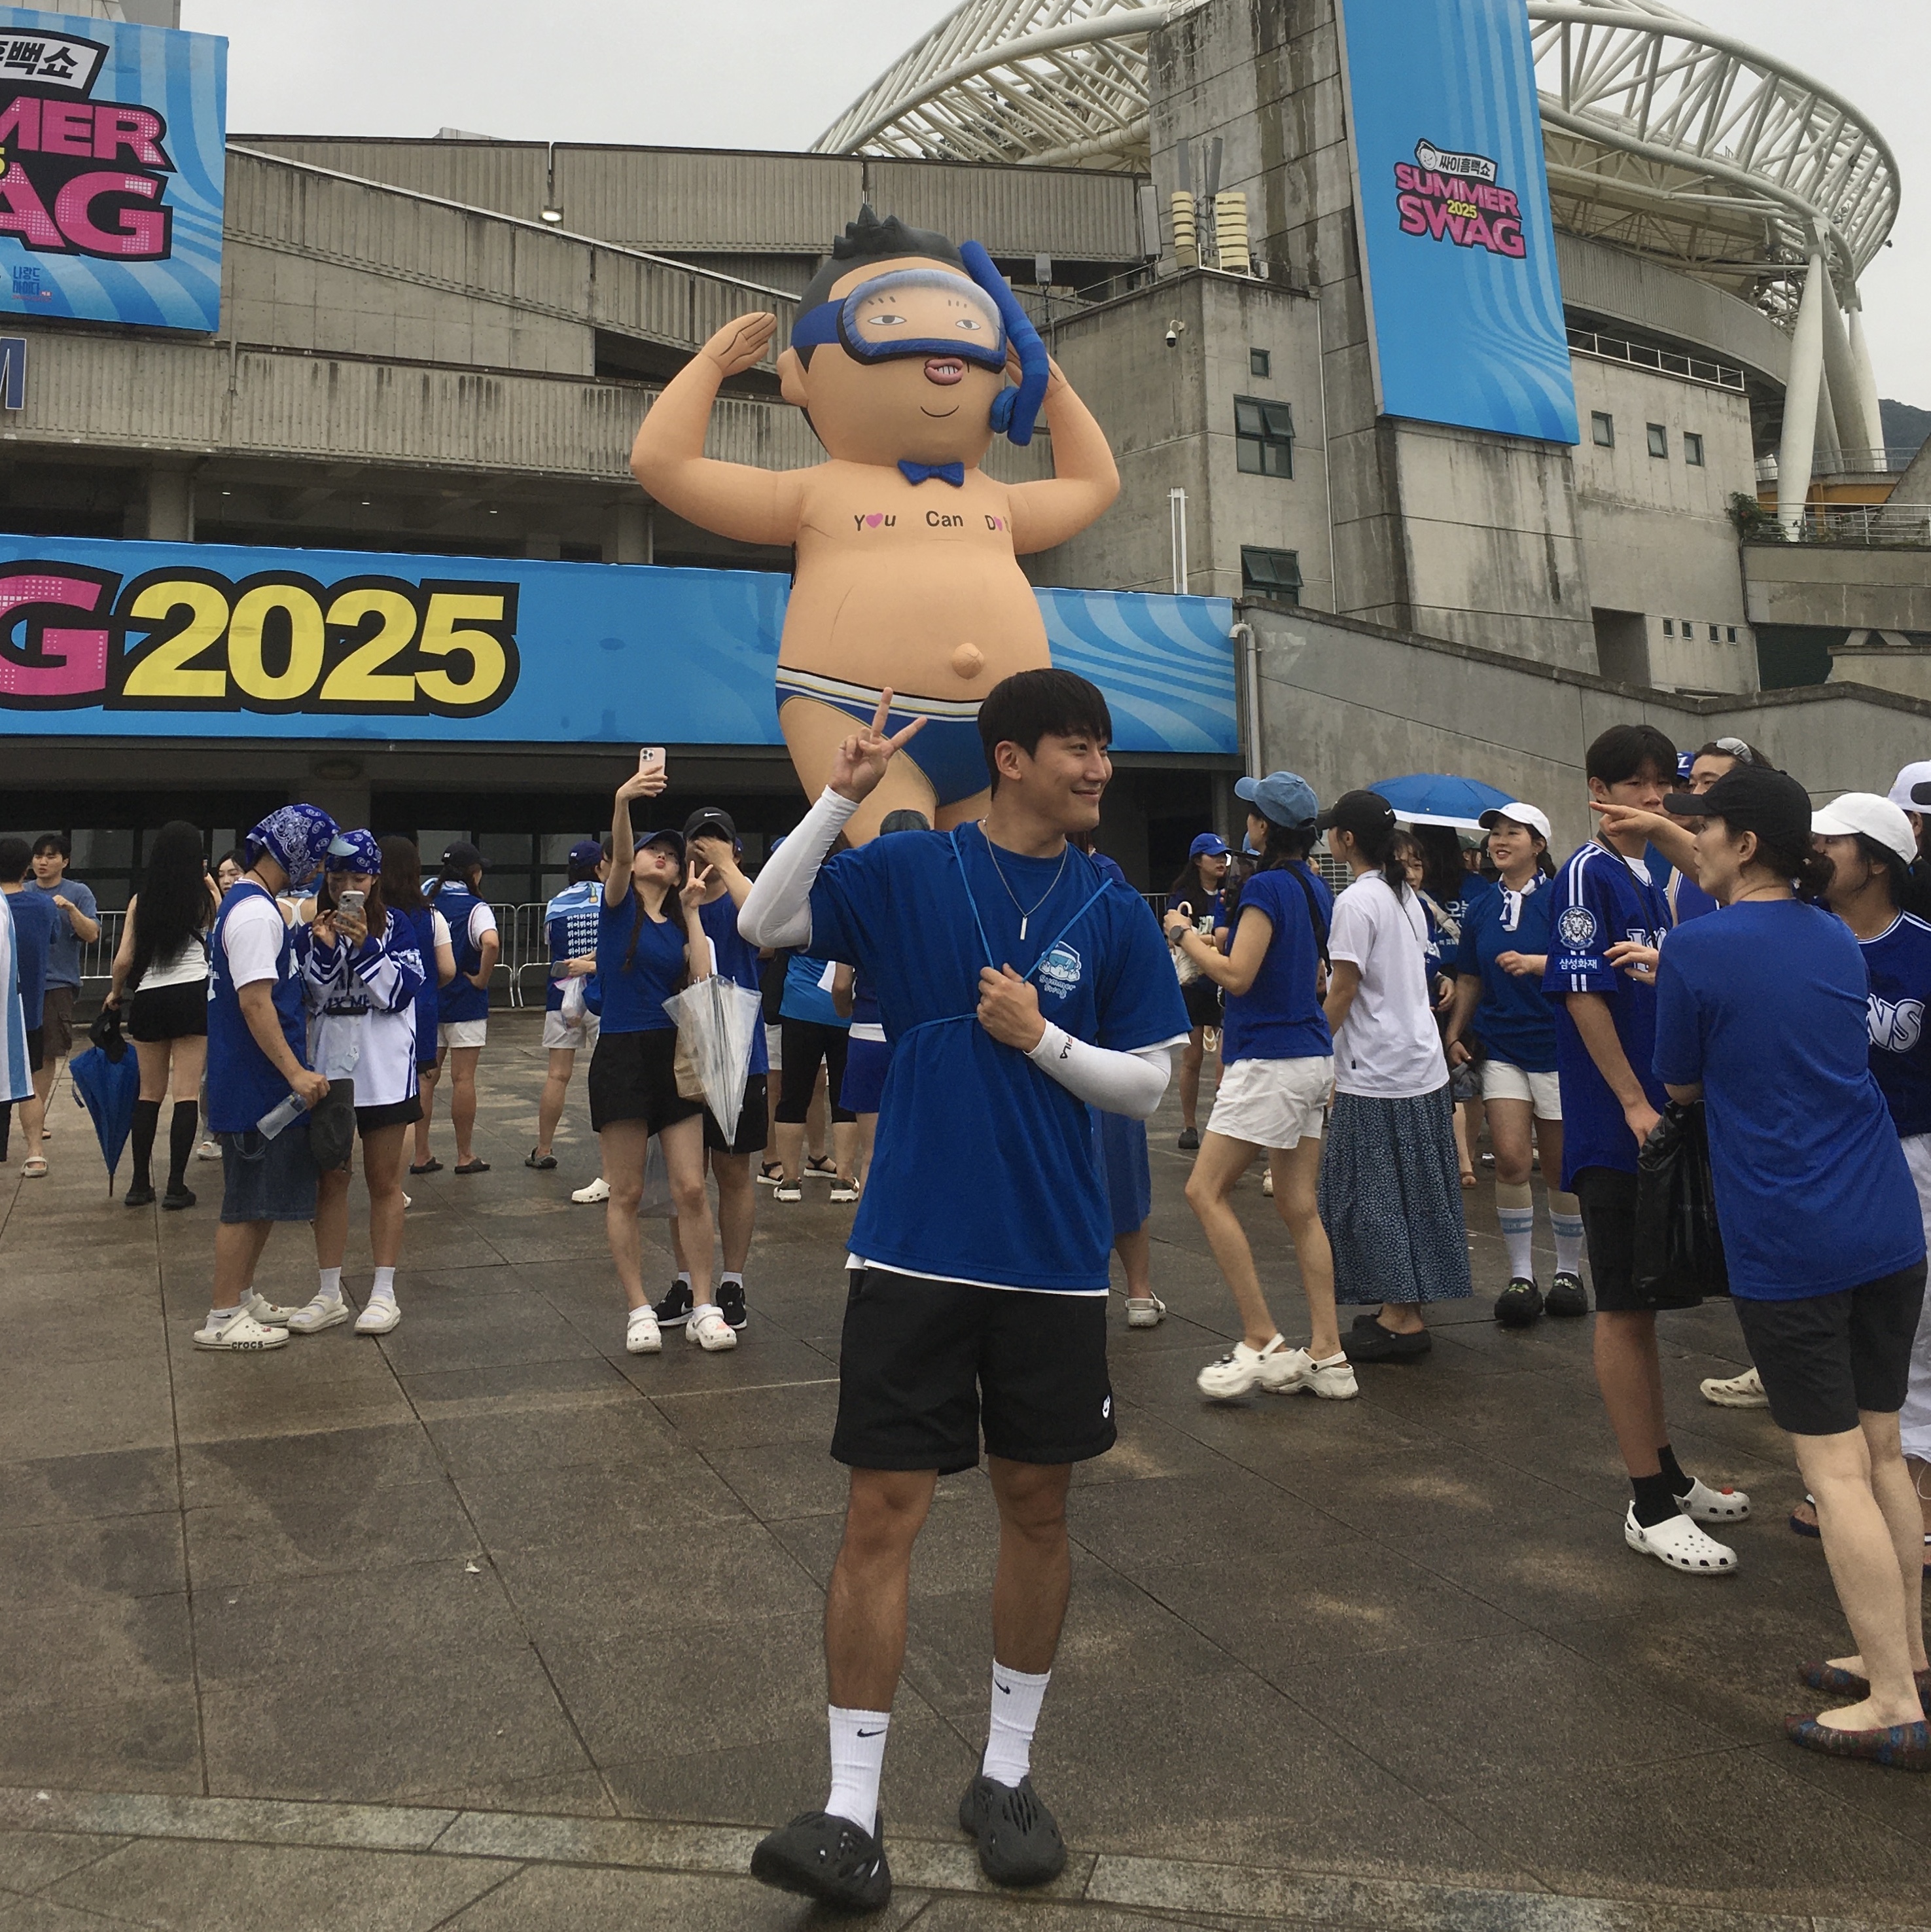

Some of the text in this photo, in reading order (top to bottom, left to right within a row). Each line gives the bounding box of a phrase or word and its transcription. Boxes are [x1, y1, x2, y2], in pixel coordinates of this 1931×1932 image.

[1396, 163, 1520, 217] SUMMER
[1446, 200, 1478, 219] 2025
[1399, 194, 1525, 257] SWAG
[13, 266, 41, 281] 나랑드
[926, 510, 964, 528] Can
[122, 581, 506, 705] 2025
[1559, 958, 1597, 970] 삼성화재
[1059, 1035, 1073, 1059] FILA
[232, 1341, 264, 1350] crocs
